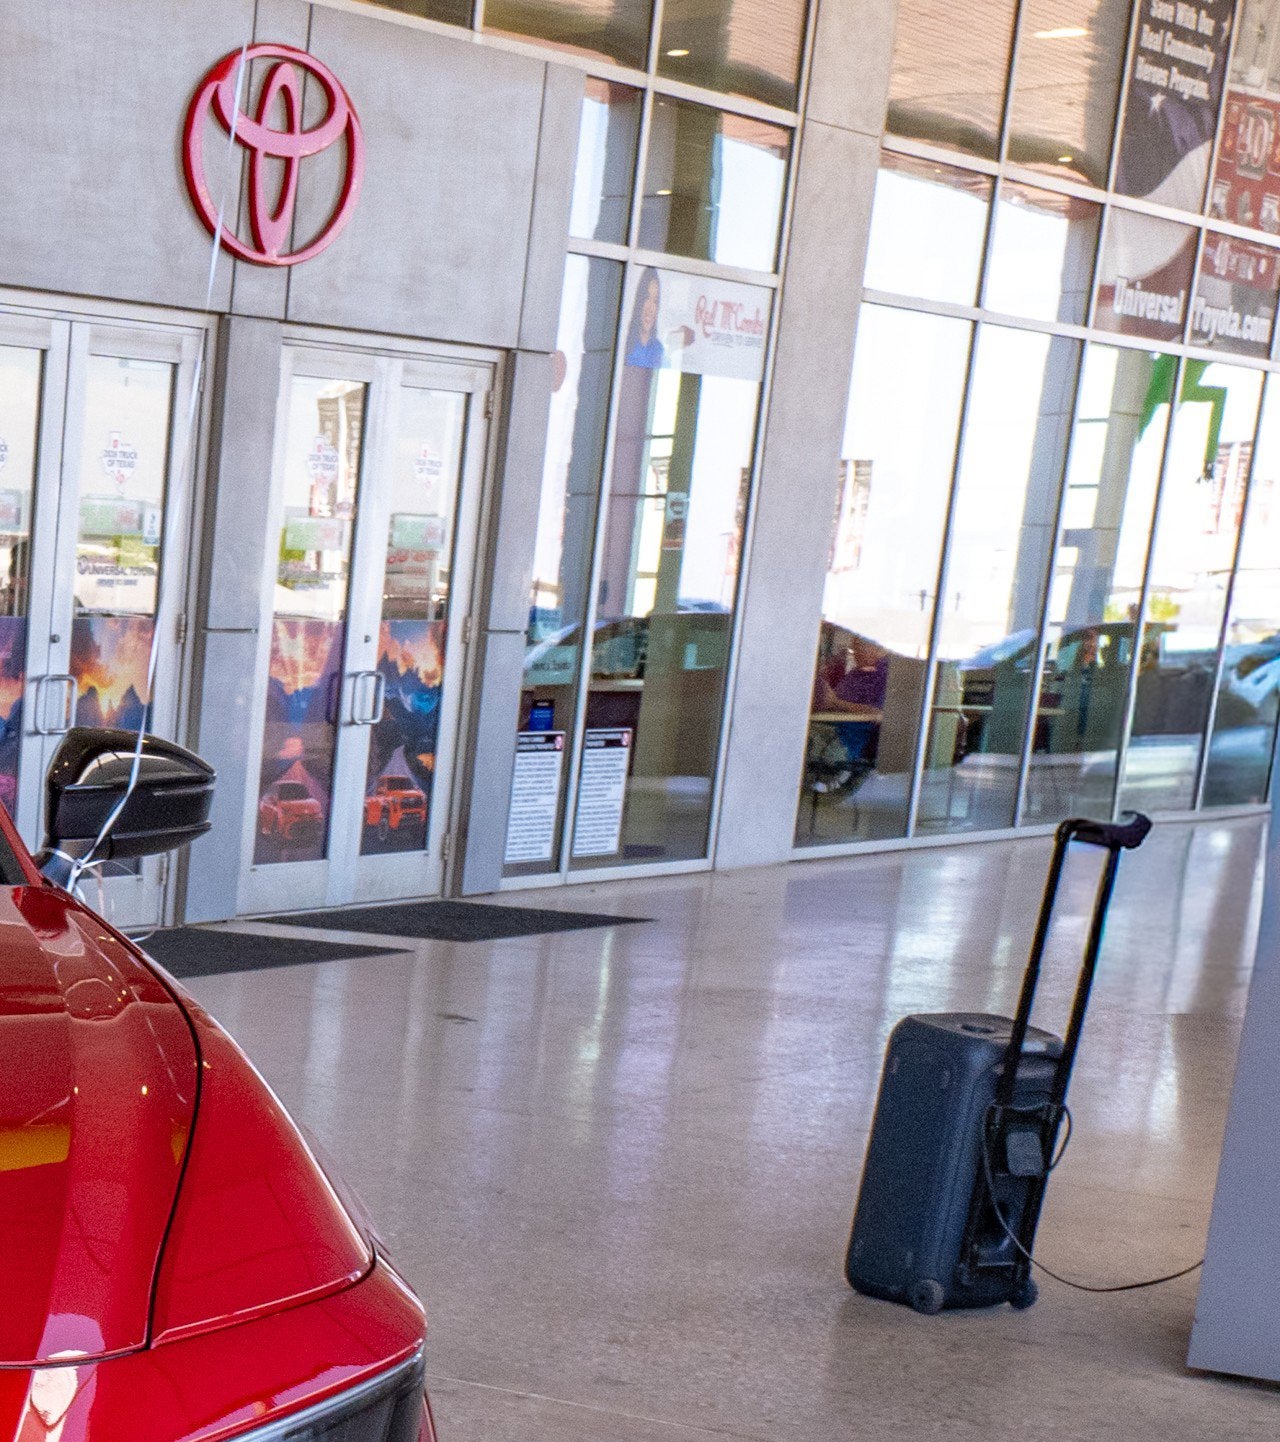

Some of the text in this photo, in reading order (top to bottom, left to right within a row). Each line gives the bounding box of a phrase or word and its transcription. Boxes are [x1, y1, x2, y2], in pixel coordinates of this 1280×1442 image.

[1149, 0, 1216, 37] Save With Our
[1140, 24, 1216, 74] Real Community
[1135, 55, 1210, 101] Heroes Program.
